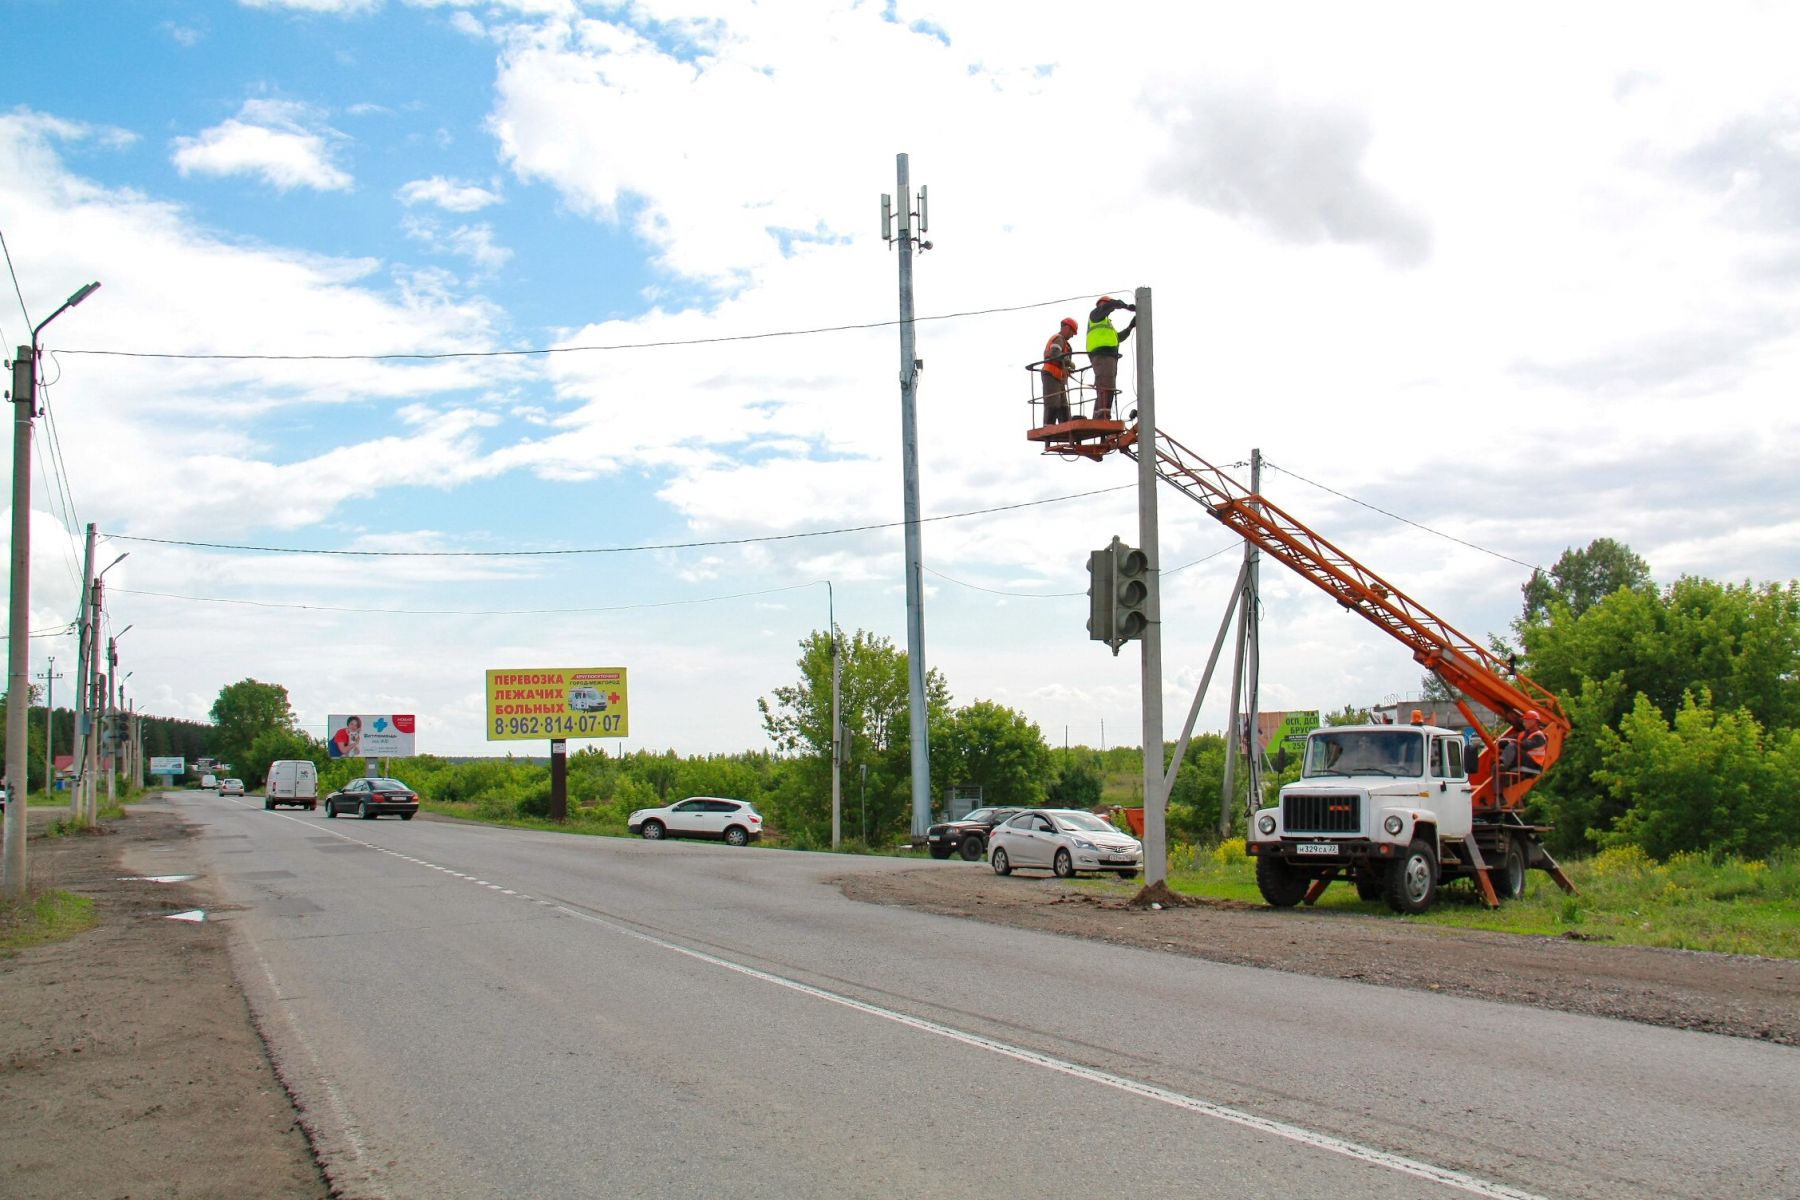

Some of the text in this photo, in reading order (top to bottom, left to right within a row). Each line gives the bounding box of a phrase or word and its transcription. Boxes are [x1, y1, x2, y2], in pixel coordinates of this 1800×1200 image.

[494, 674, 564, 685] ПЕРЕВОЗКА
[495, 689, 564, 700] ЛЕЖАЧИХ
[495, 704, 564, 715] БОЛЬНЫХ
